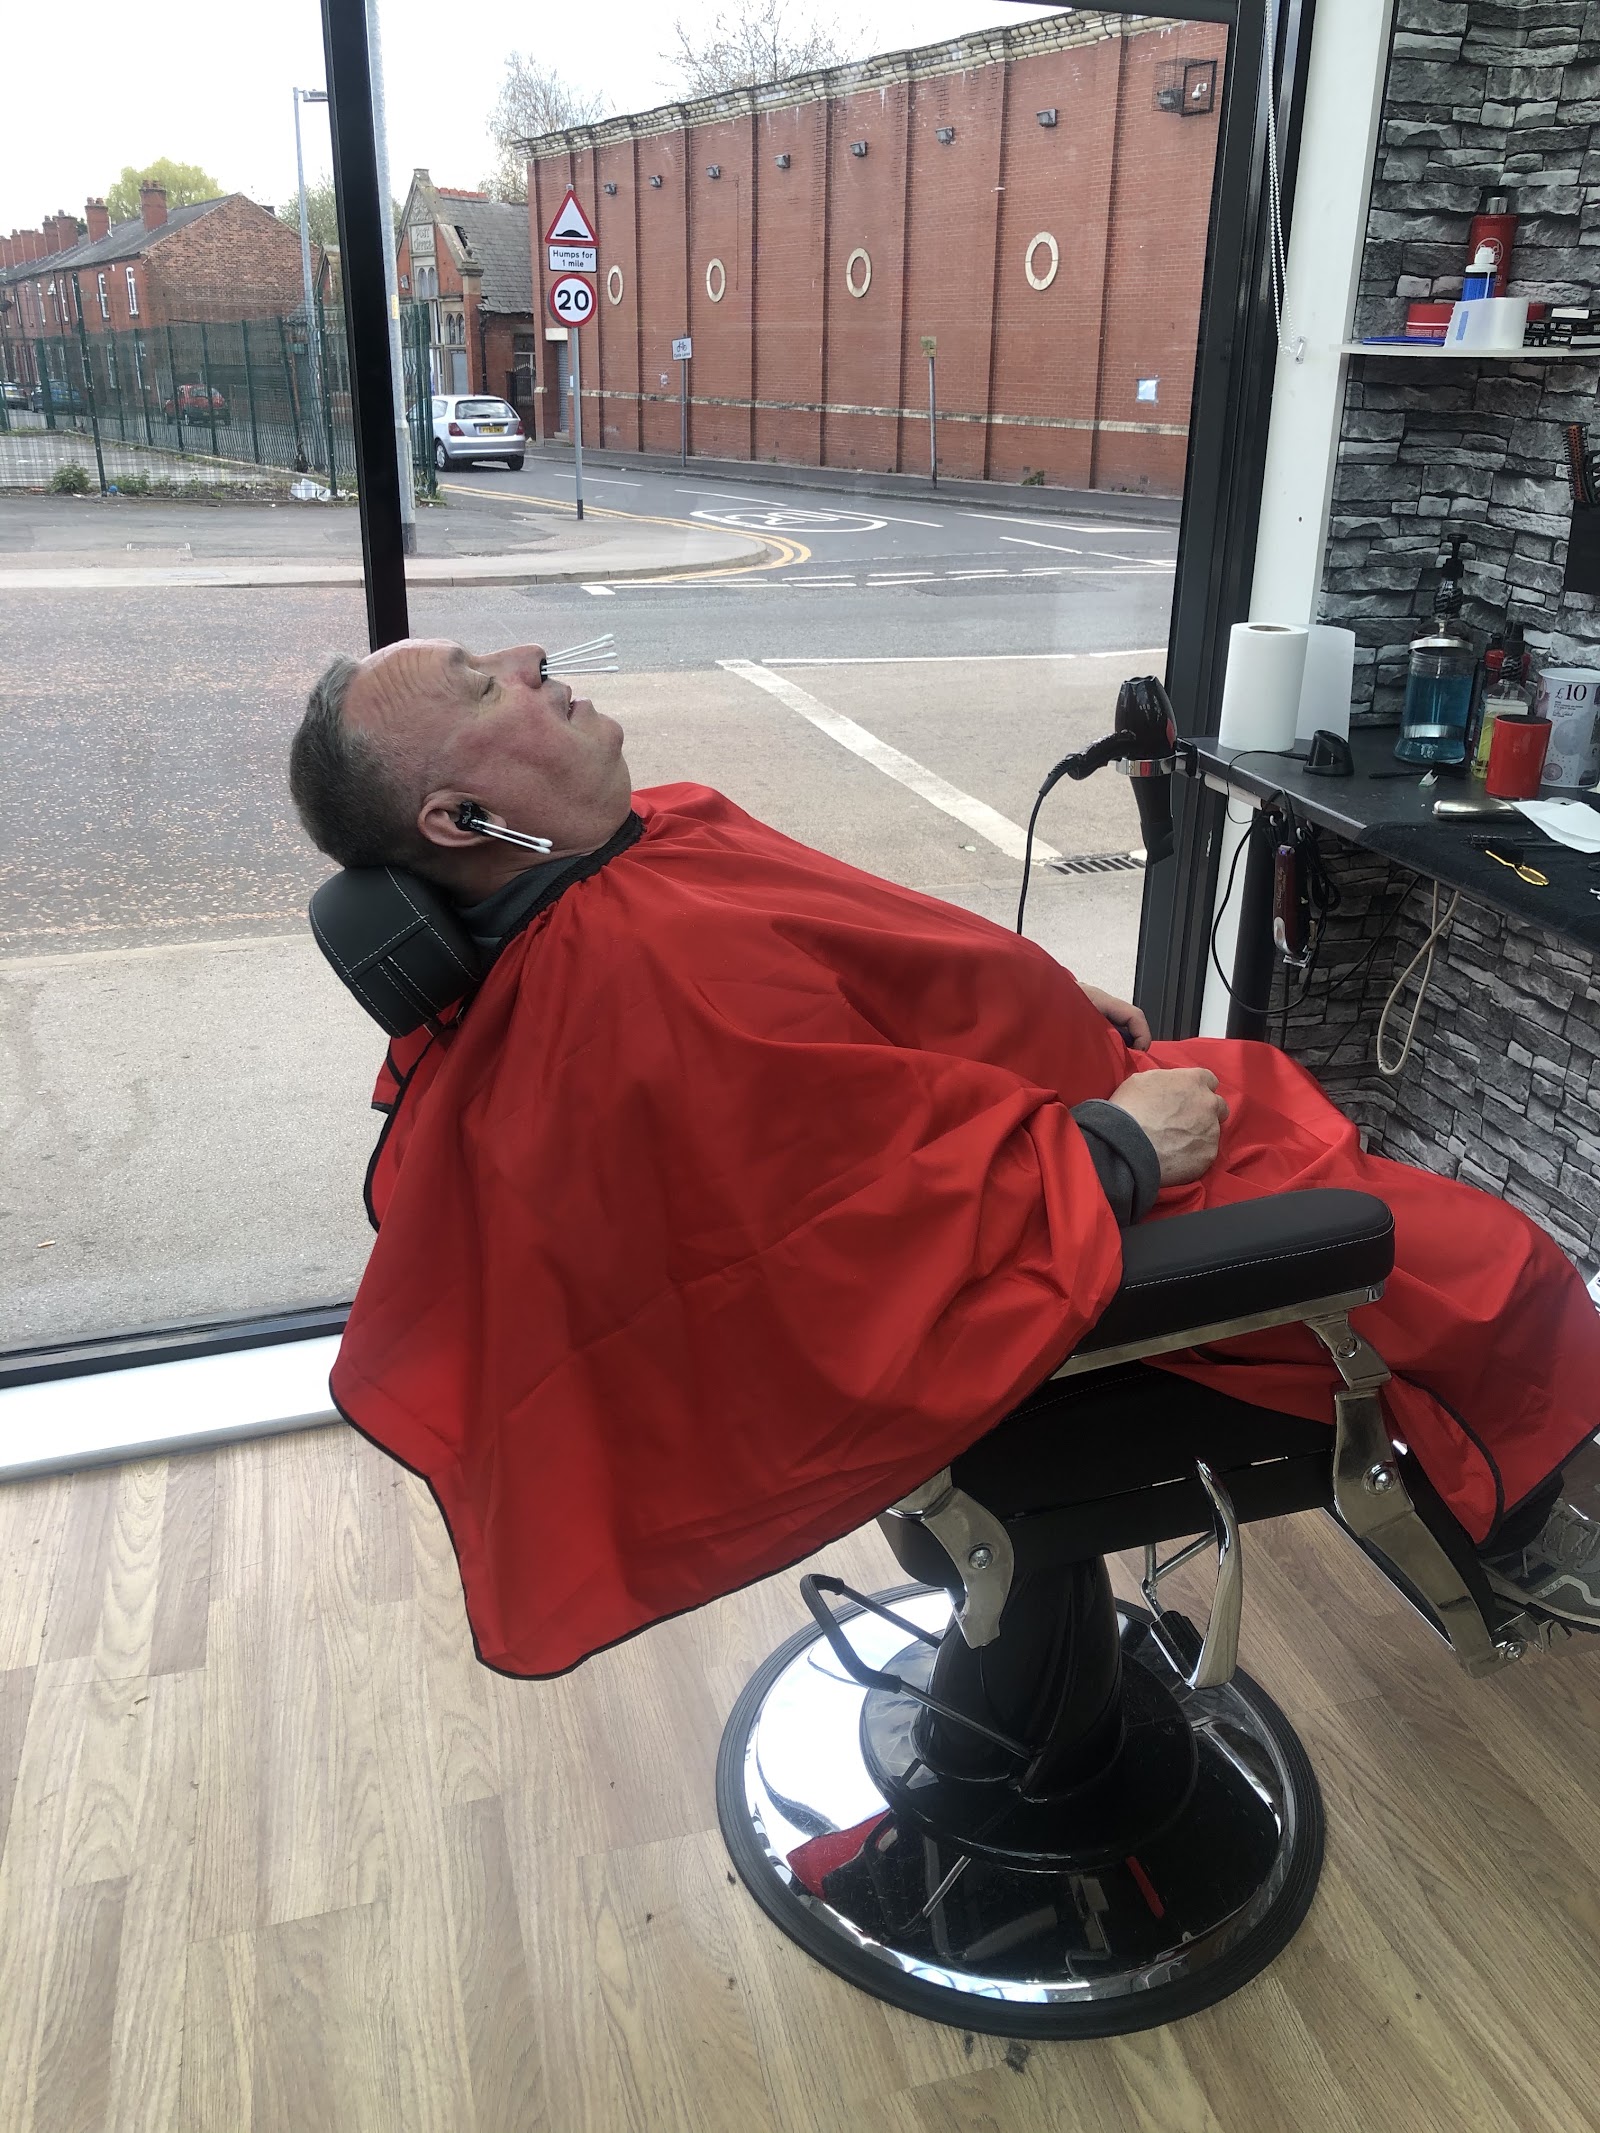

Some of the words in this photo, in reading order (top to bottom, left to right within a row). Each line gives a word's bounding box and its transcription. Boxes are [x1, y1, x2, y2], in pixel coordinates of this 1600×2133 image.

[552, 250, 580, 259] Humps
[582, 251, 593, 259] for
[562, 259, 566, 267] 1
[557, 289, 589, 311] 20
[1555, 684, 1587, 702] £10
